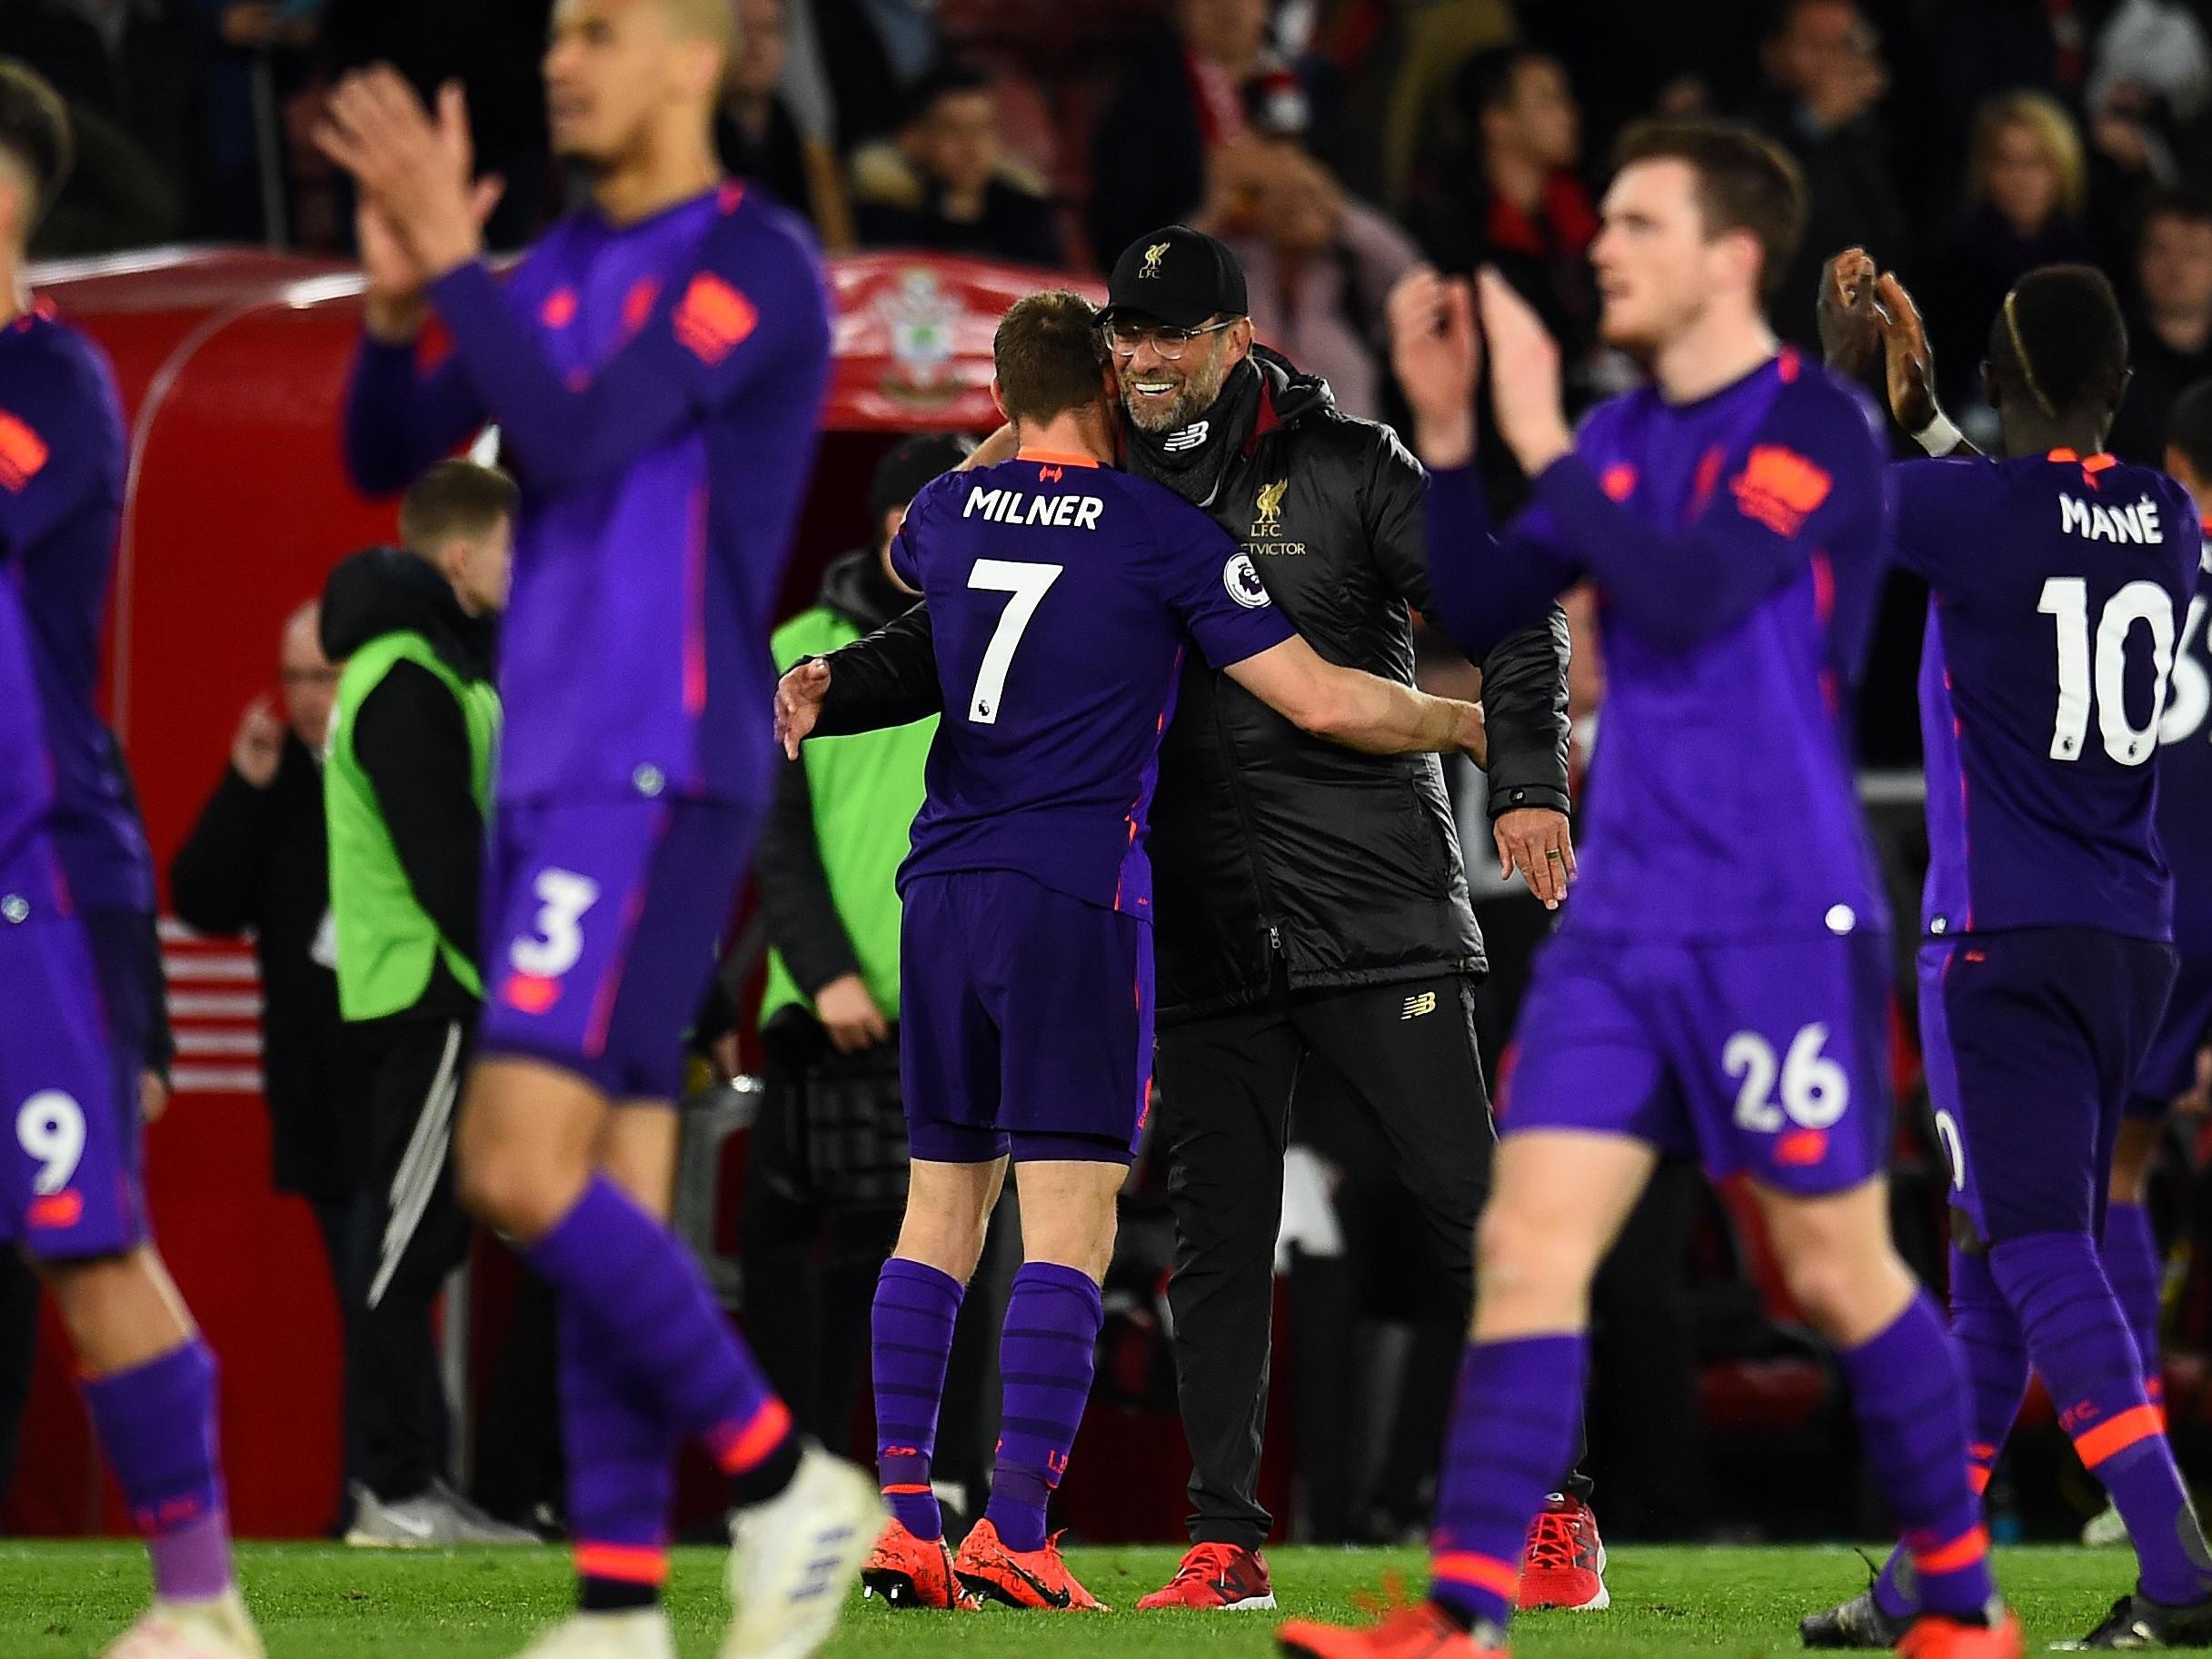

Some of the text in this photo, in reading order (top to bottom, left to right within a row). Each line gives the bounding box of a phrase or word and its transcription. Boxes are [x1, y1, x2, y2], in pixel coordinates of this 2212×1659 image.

[962, 486, 1103, 530] MILNER
[967, 558, 1063, 724] 7
[2037, 576, 2175, 766] 10
[509, 866, 602, 978] 3
[1722, 1021, 1849, 1133] 26
[15, 1088, 87, 1196] 9
